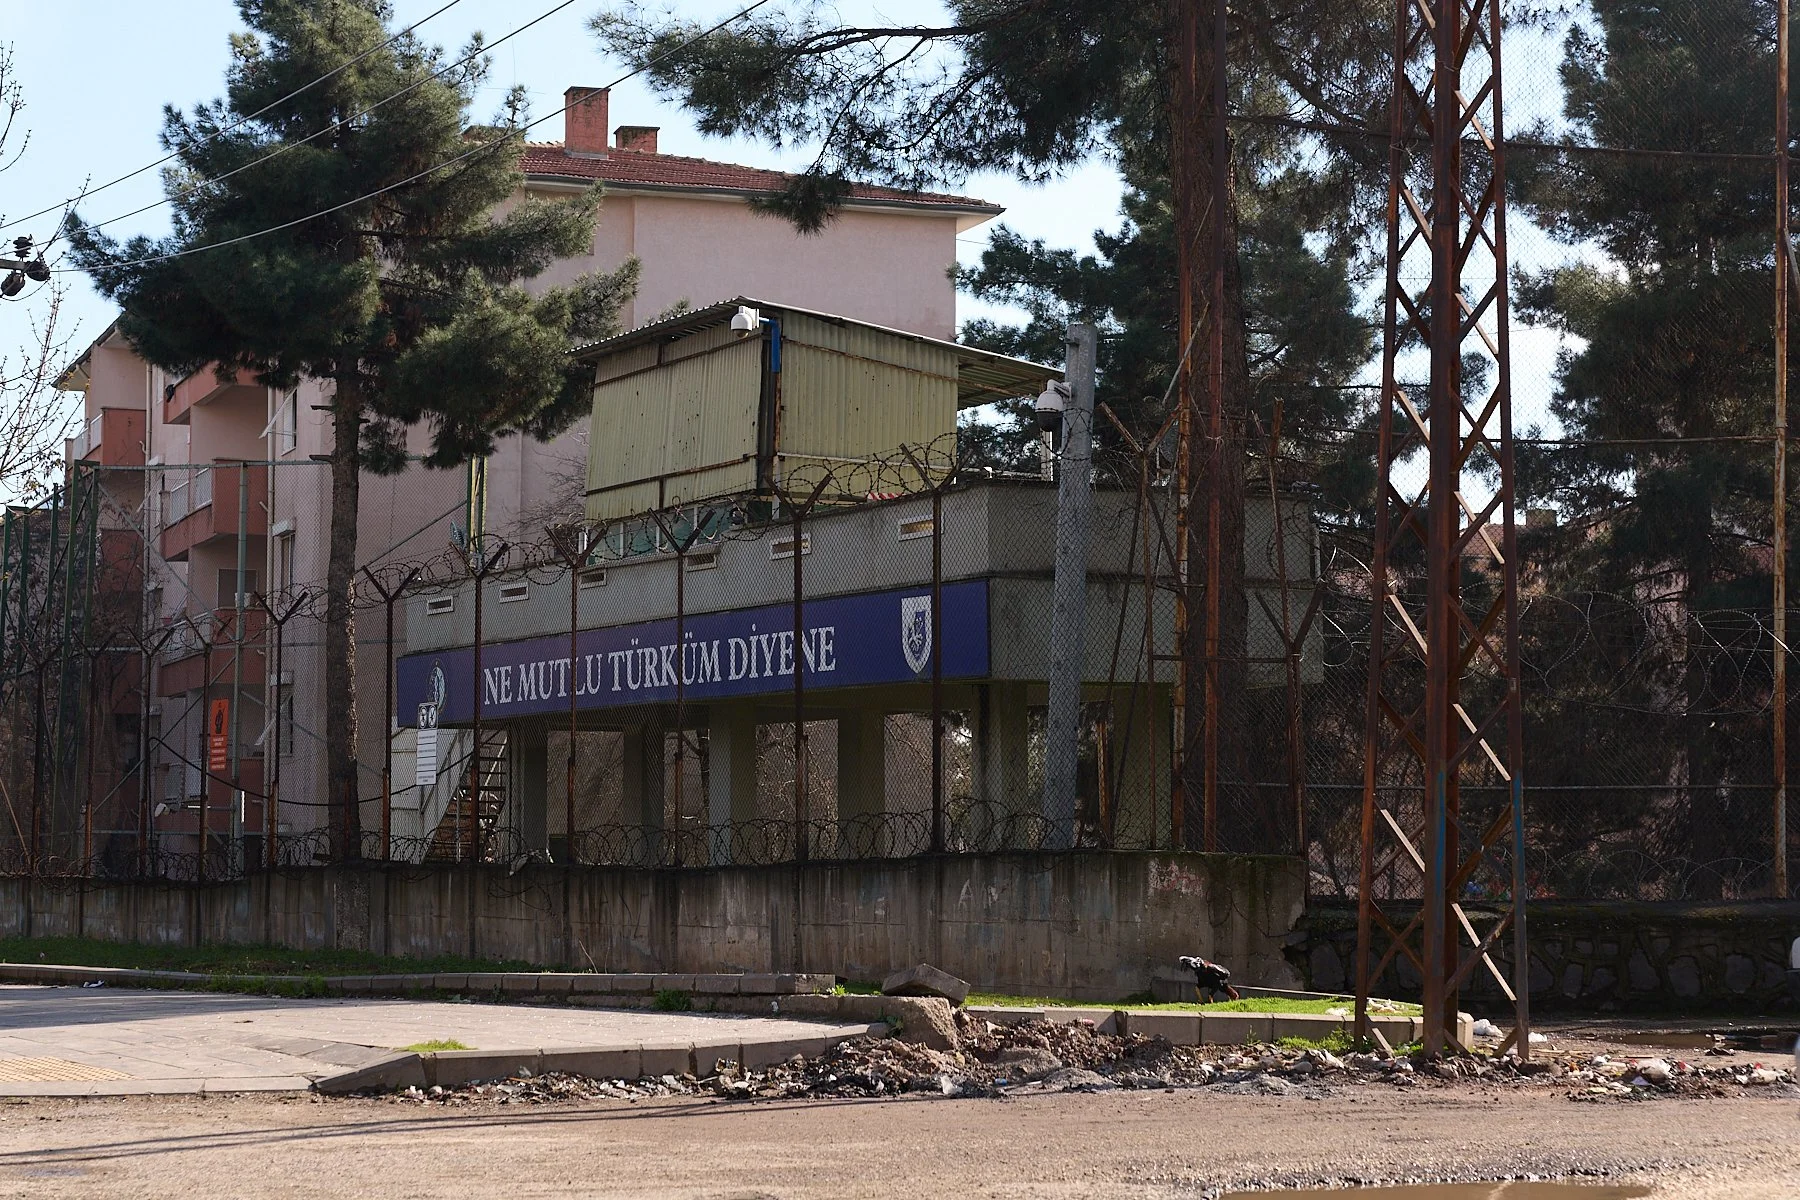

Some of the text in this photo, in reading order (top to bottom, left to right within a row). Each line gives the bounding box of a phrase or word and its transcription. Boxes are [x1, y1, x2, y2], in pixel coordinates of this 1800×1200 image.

[484, 666, 512, 705] NE
[608, 631, 721, 692] TÜRKÜM
[728, 623, 836, 680] DİYENE
